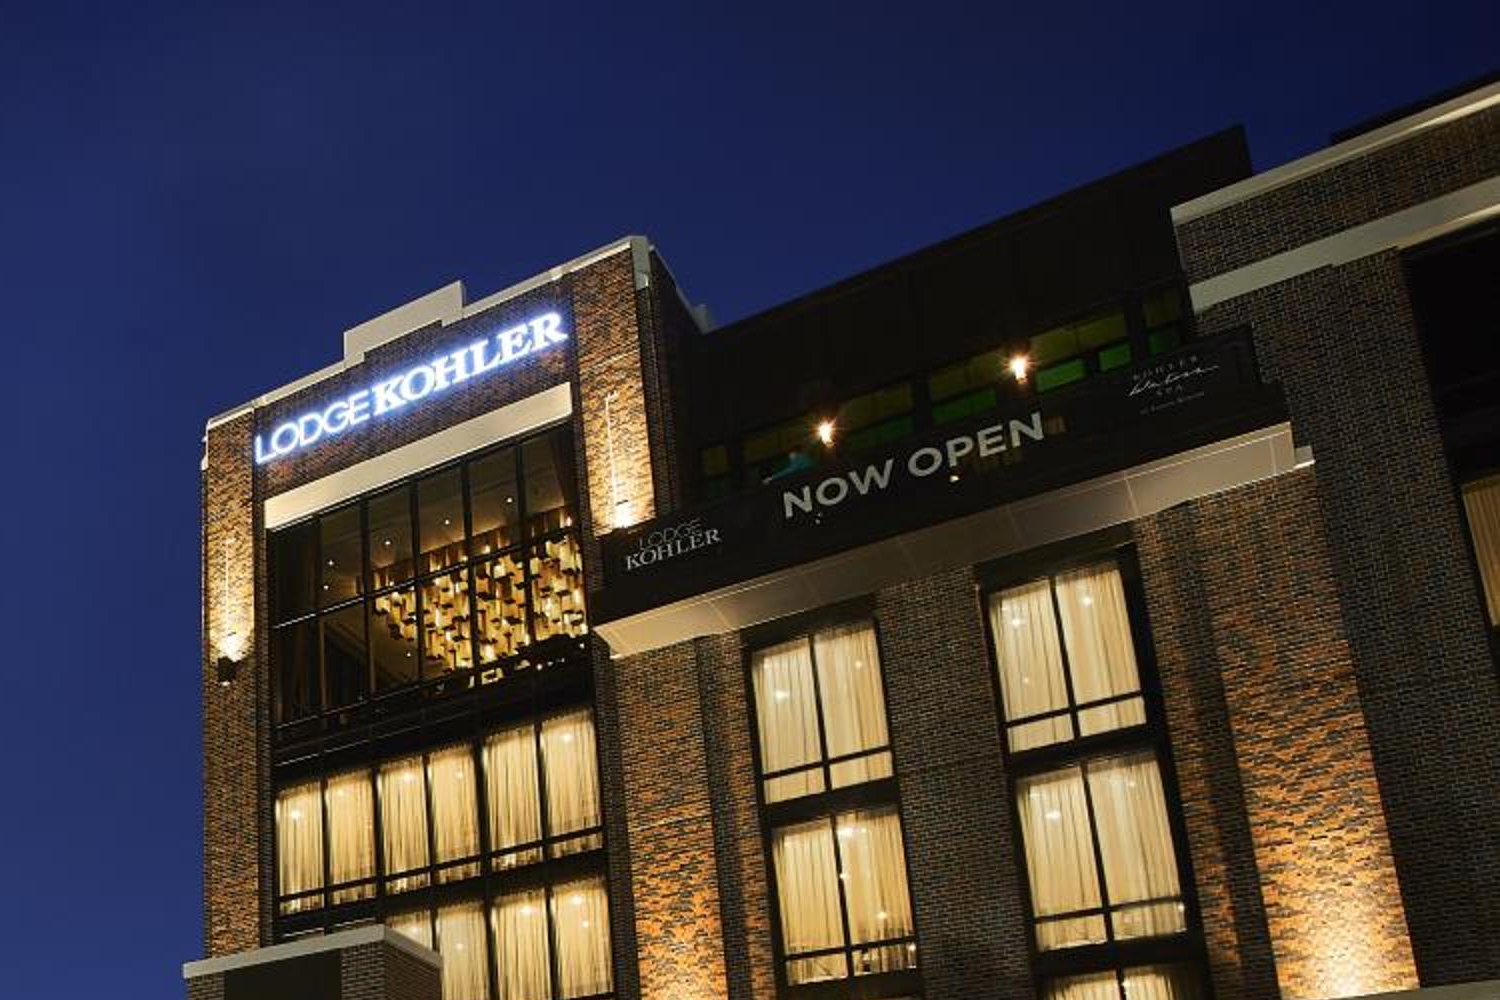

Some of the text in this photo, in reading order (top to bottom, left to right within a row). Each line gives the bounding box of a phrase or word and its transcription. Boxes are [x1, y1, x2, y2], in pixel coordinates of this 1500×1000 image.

[254, 311, 568, 465] LODGE KOHLER
[783, 411, 1045, 518] NOW OPEN
[626, 528, 722, 571] KOHLER
[639, 518, 703, 551] LODGE
